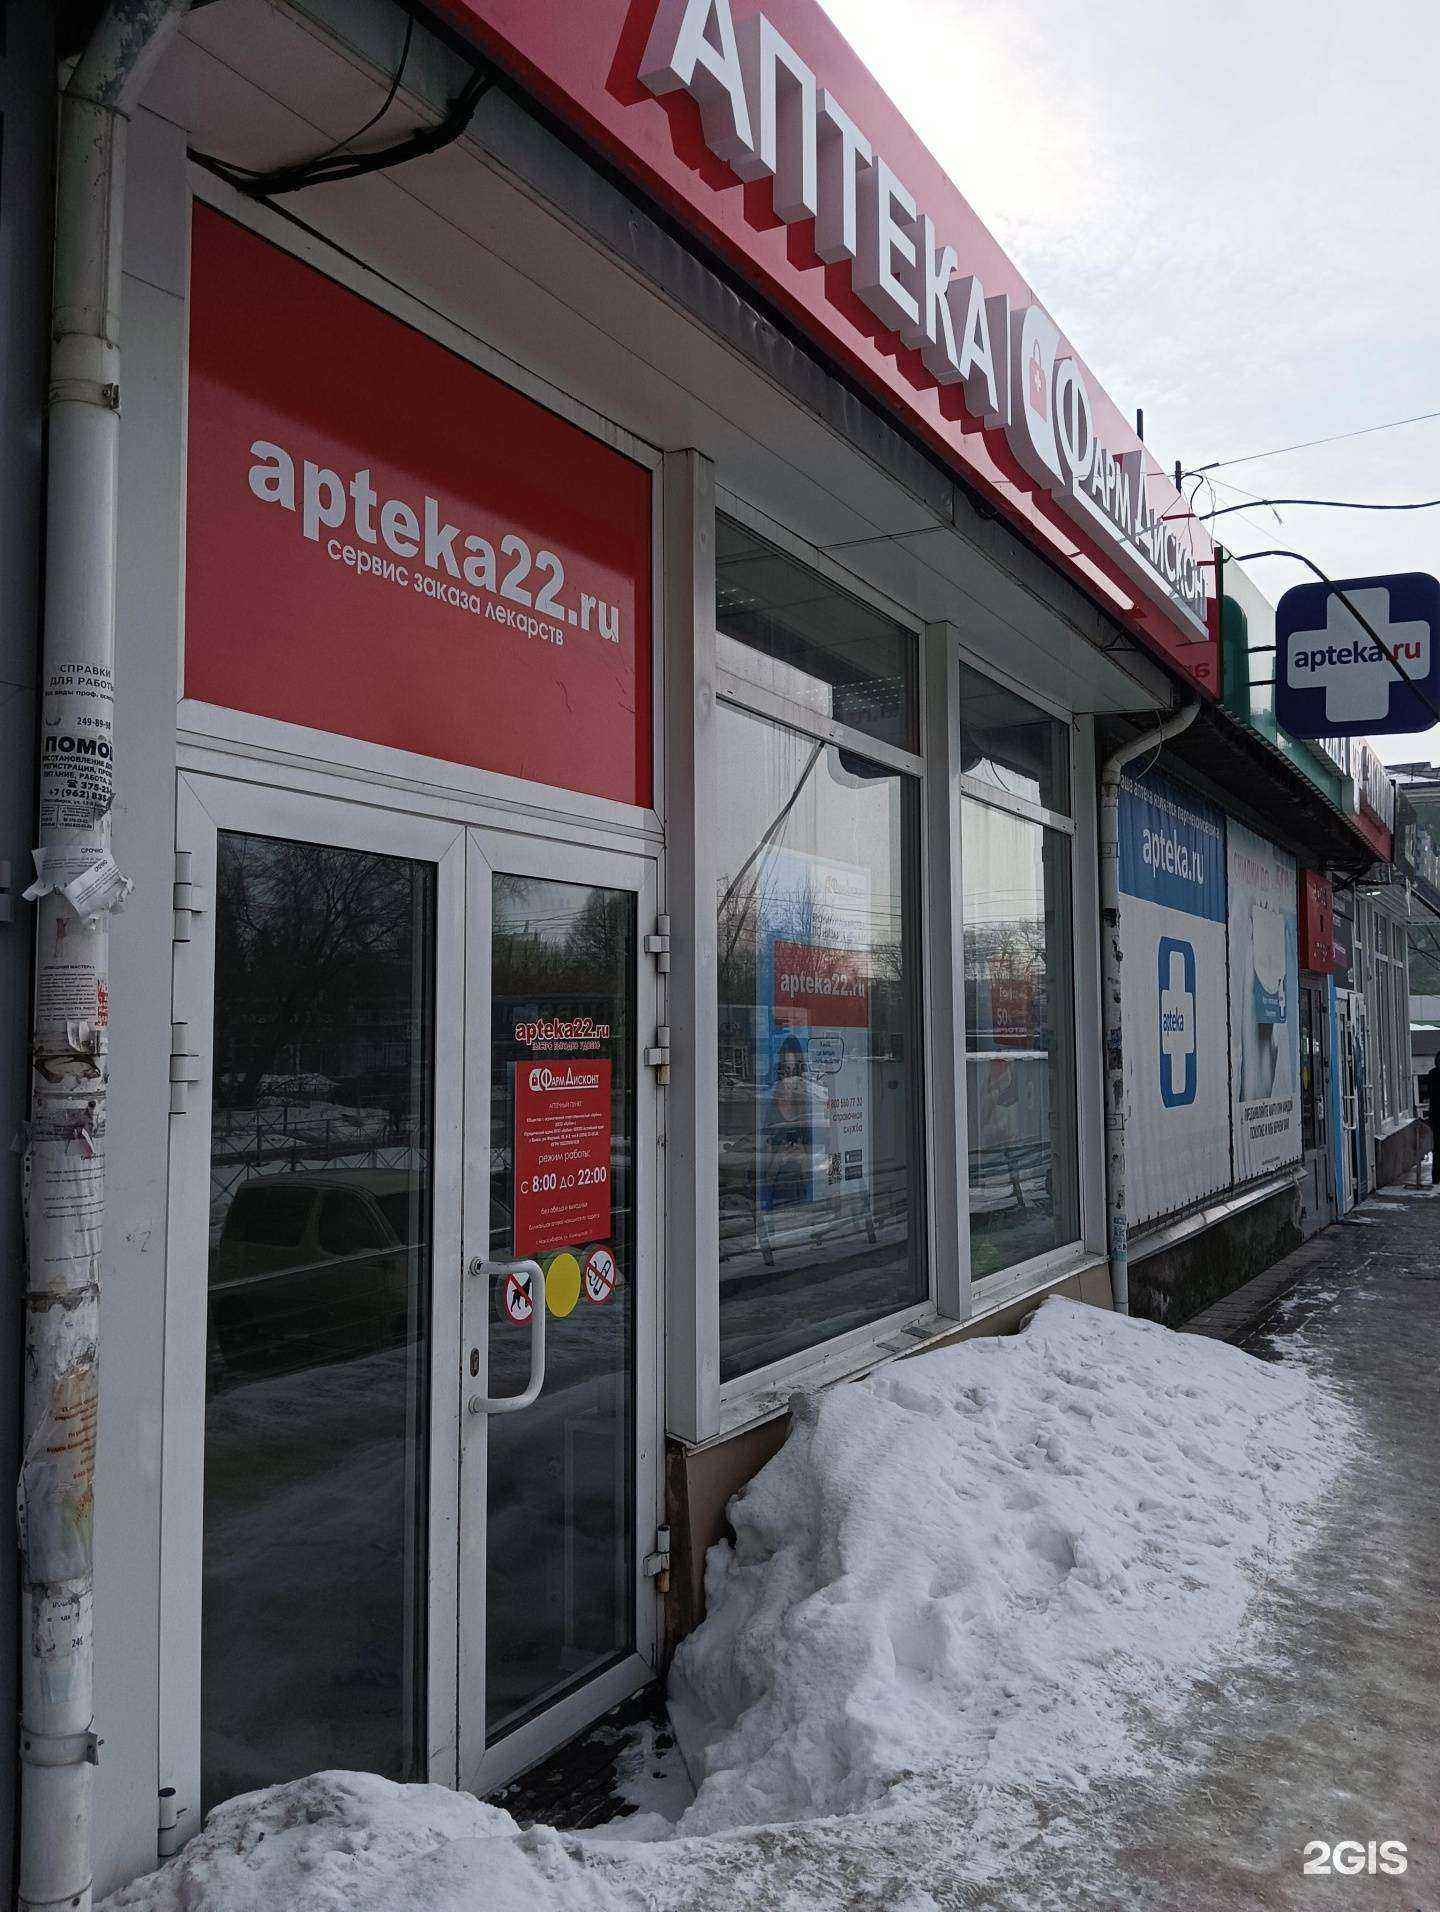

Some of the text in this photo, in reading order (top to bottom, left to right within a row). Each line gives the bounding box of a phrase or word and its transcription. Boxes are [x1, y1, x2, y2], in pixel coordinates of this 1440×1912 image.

[666, 0, 999, 415] АПТЕКА
[248, 440, 620, 643] apteka22.ru
[327, 538, 565, 646] сервис заказа лекарств
[50, 676, 73, 687] ДЛЯ
[60, 664, 111, 678] СПРАВКИ
[1142, 827, 1204, 884] apteka.ru
[515, 1018, 610, 1046] apteka22.ru
[532, 1173, 556, 1192] 8:00
[577, 1166, 607, 1186] 22:00
